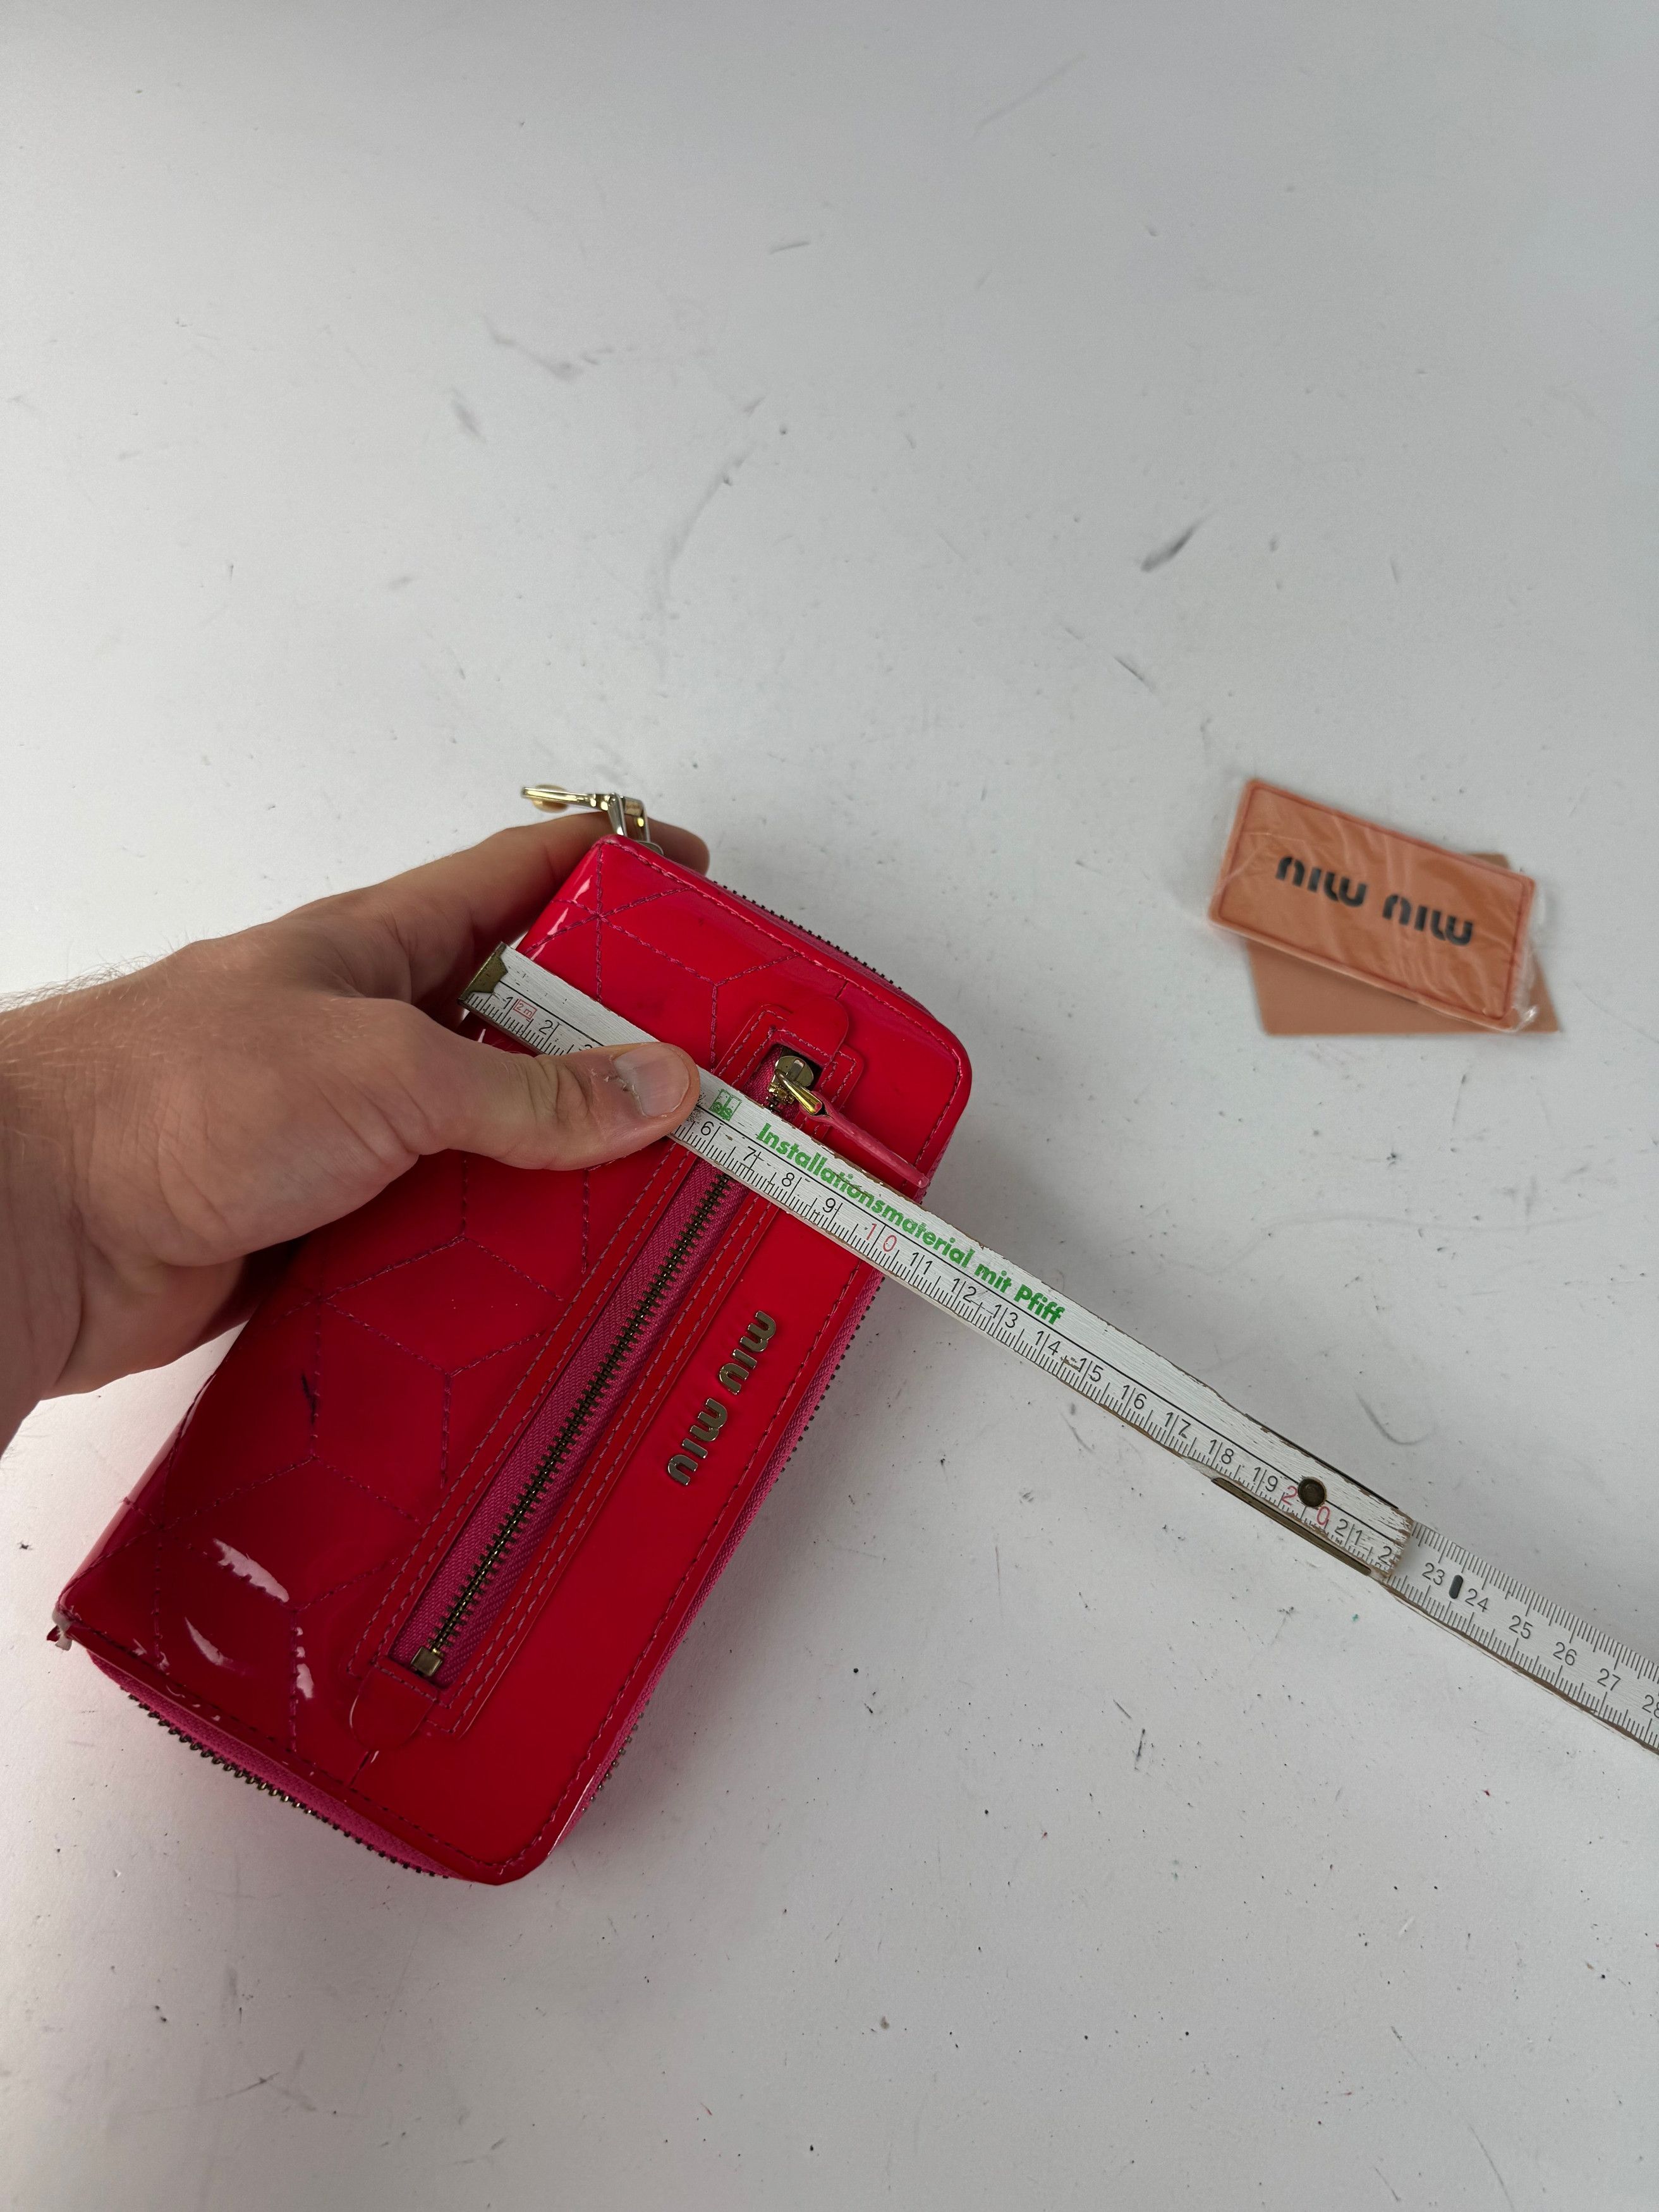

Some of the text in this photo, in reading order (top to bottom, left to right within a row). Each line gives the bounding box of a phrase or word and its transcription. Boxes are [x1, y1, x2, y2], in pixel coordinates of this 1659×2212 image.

[503, 997, 513, 1009] 1
[539, 1019, 553, 1035] 2
[700, 1121, 714, 1136] 6
[743, 1146, 757, 1162] 7
[782, 1172, 794, 1187] 8
[822, 1198, 836, 1213] 9
[866, 1224, 897, 1252] 10
[910, 1252, 933, 1275] 11
[951, 1279, 976, 1302] 12
[992, 1304, 1018, 1328] 13
[1035, 1330, 1061, 1356] 14
[1079, 1358, 1103, 1382] 15
[1121, 1385, 1146, 1409] 16
[1165, 1412, 1191, 1435] 17
[1208, 1439, 1234, 1464] 18
[1252, 1467, 1278, 1492] 19
[1334, 1519, 1363, 1545] 21
[757, 1122, 1065, 1325] Installationsmaterial mit Pfiff
[1421, 1562, 1445, 1586] 23
[1465, 1588, 1488, 1612] 24
[1509, 1615, 1533, 1639] 25
[1553, 1642, 1577, 1666] 26
[1597, 1668, 1621, 1691] 27
